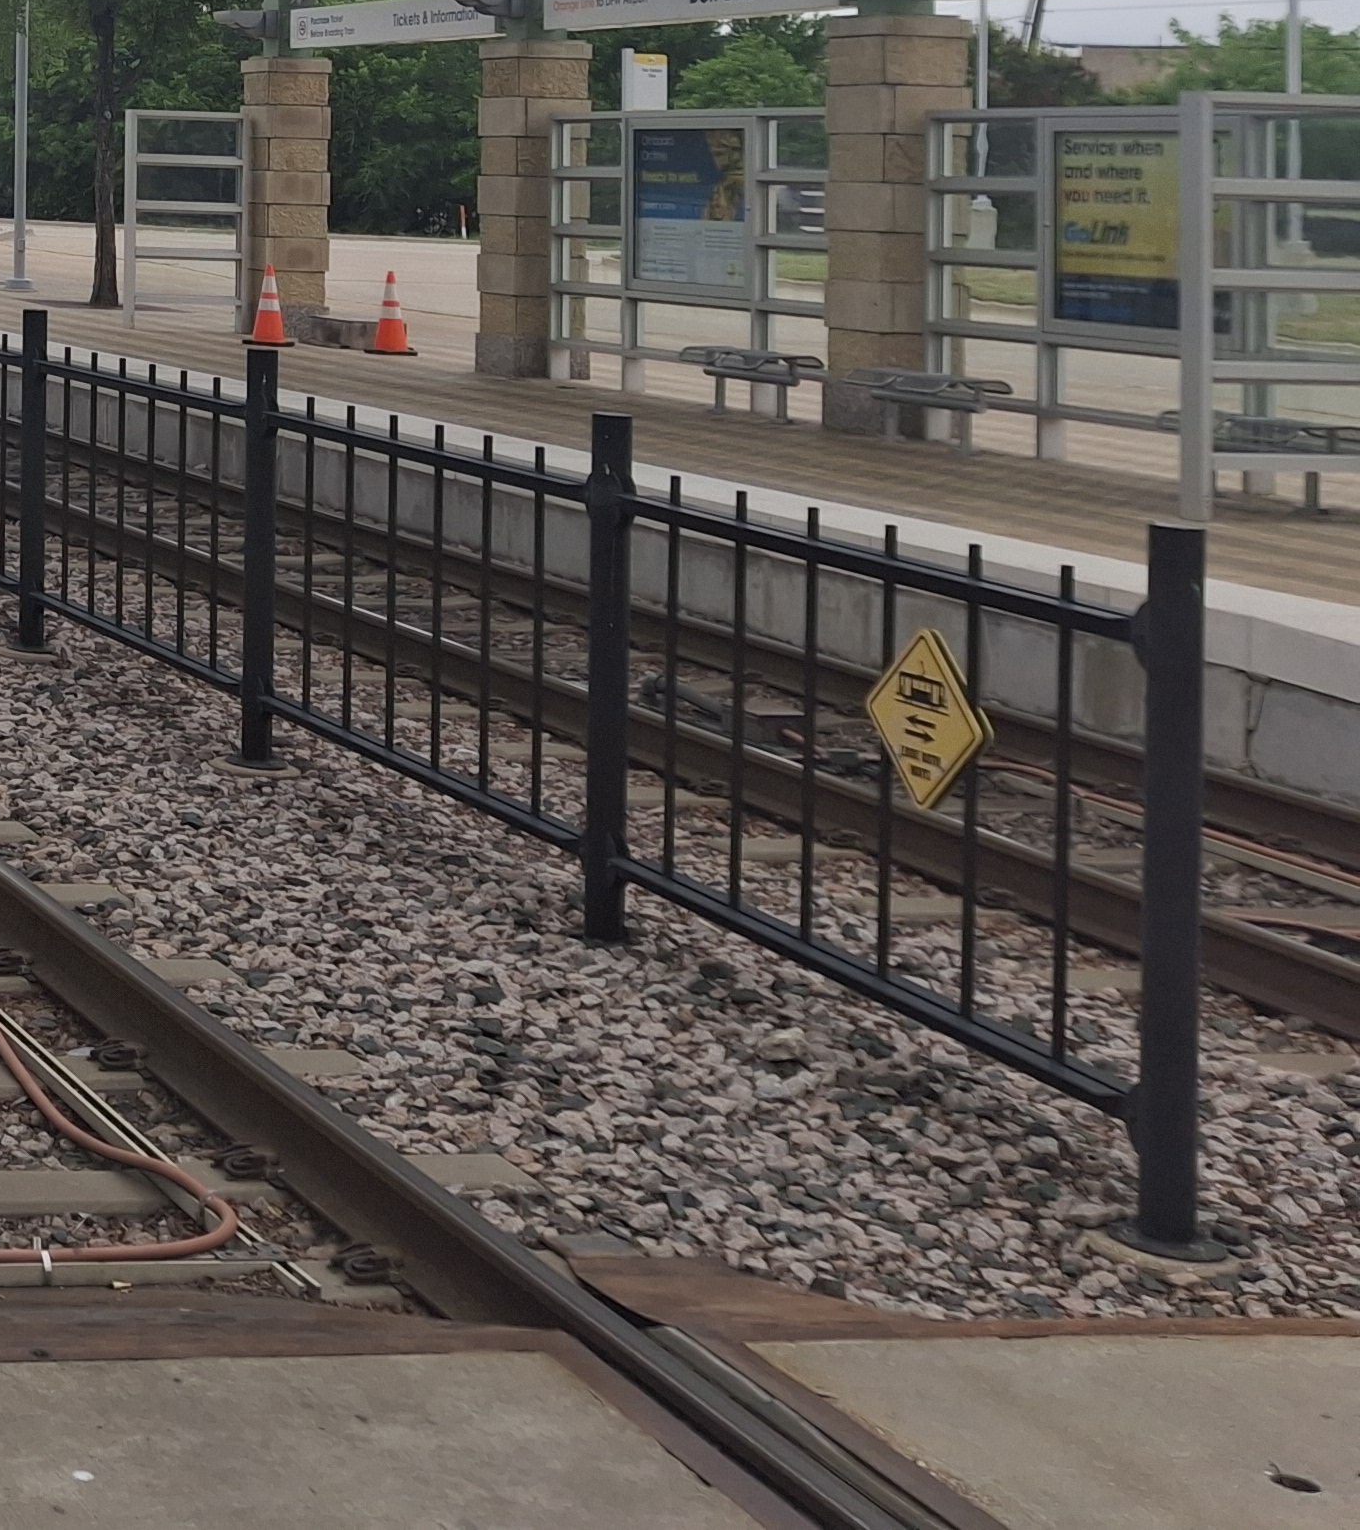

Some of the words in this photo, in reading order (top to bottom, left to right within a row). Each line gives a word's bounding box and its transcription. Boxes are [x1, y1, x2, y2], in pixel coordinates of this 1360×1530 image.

[393, 12, 420, 27] Tickets
[422, 10, 428, 25] &
[430, 6, 479, 23] Information
[1064, 138, 1117, 156] Service
[1123, 139, 1164, 156] when
[1064, 164, 1093, 179] and
[1098, 163, 1144, 180] where
[1064, 190, 1091, 205] you
[1094, 188, 1132, 204] need
